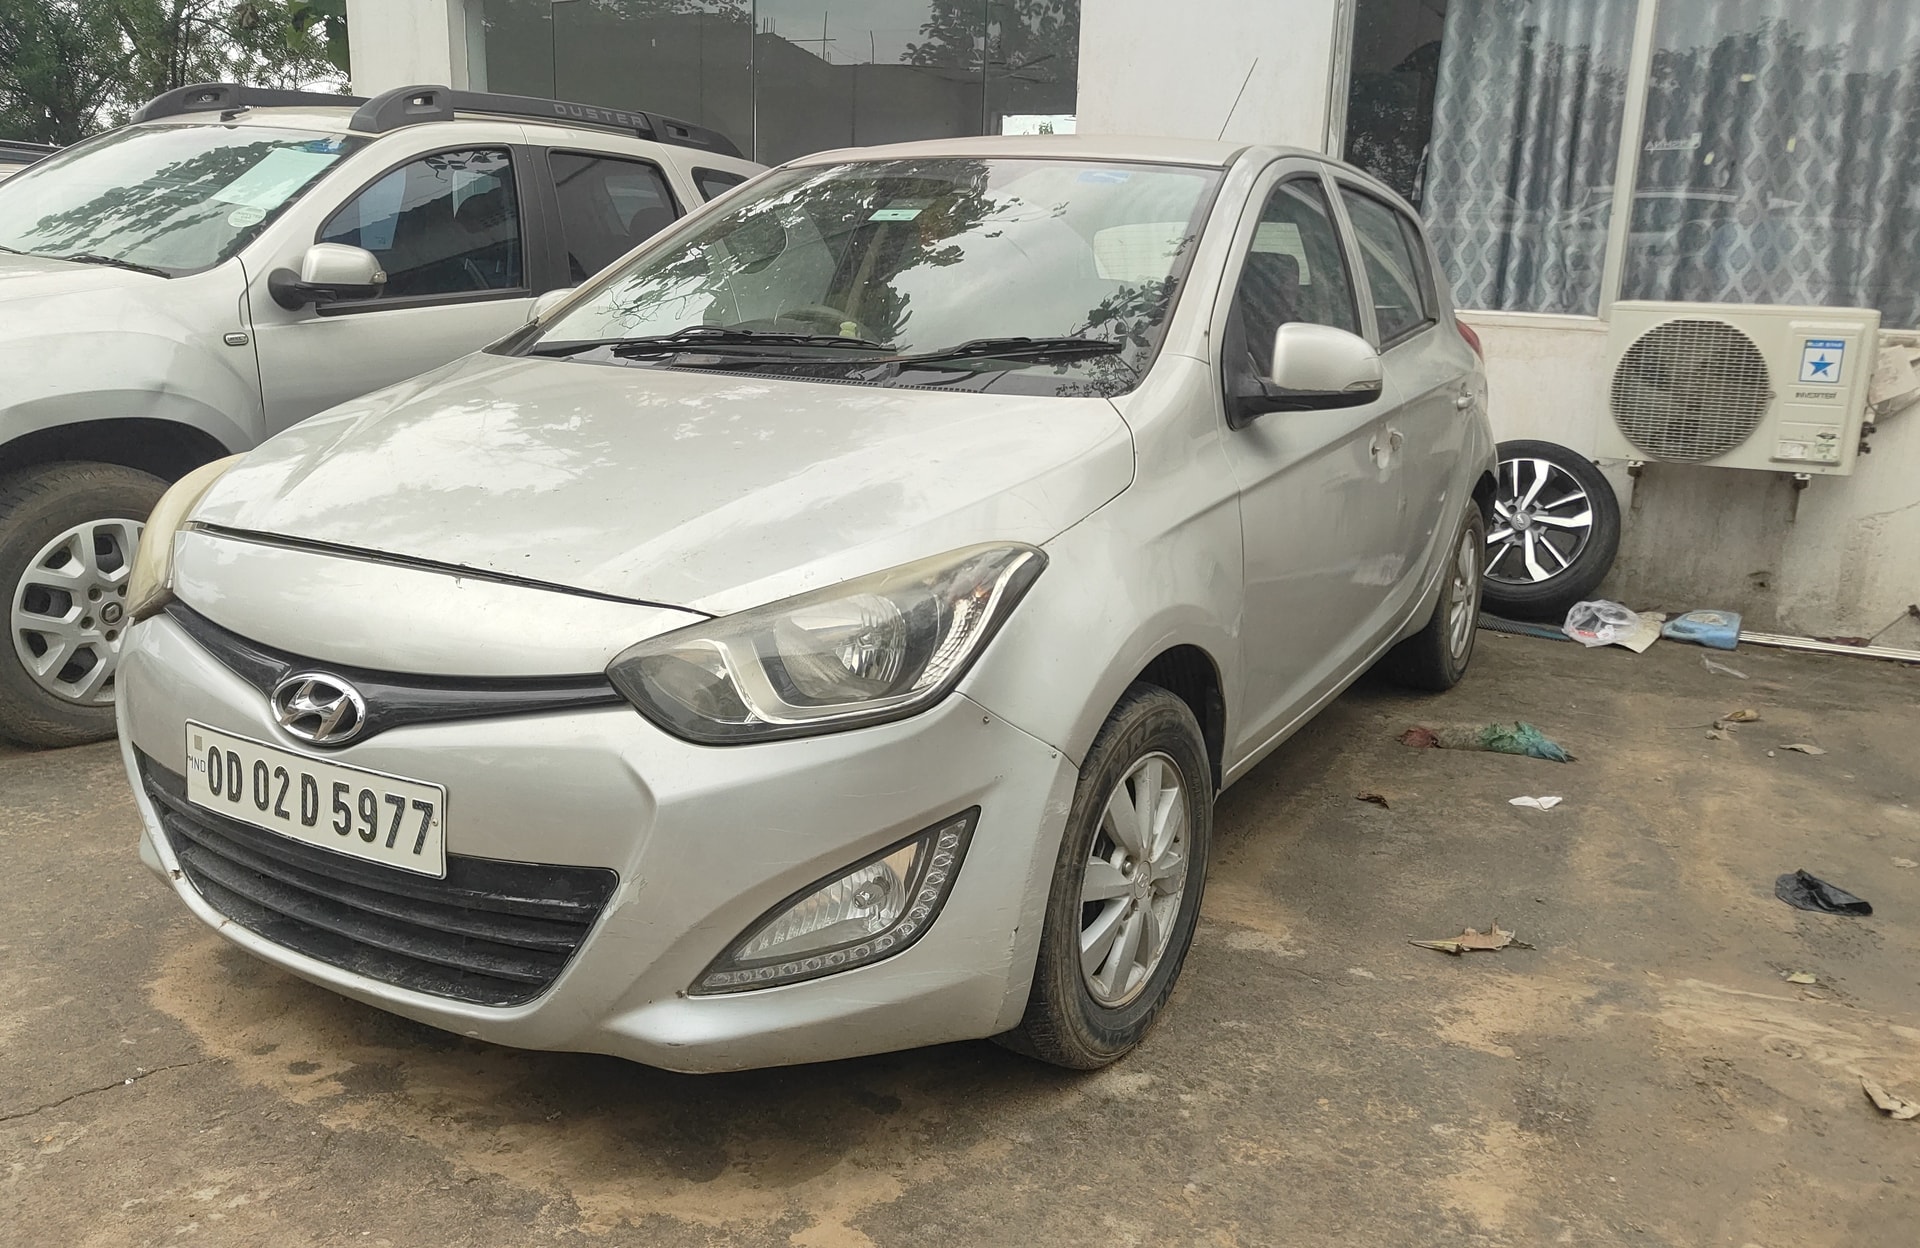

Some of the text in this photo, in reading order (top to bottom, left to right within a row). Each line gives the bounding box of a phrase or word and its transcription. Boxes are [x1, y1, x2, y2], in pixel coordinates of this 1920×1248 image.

[553, 104, 643, 126] DUSTER
[190, 757, 206, 773] IND
[207, 746, 434, 855] OD 02 D 5977
